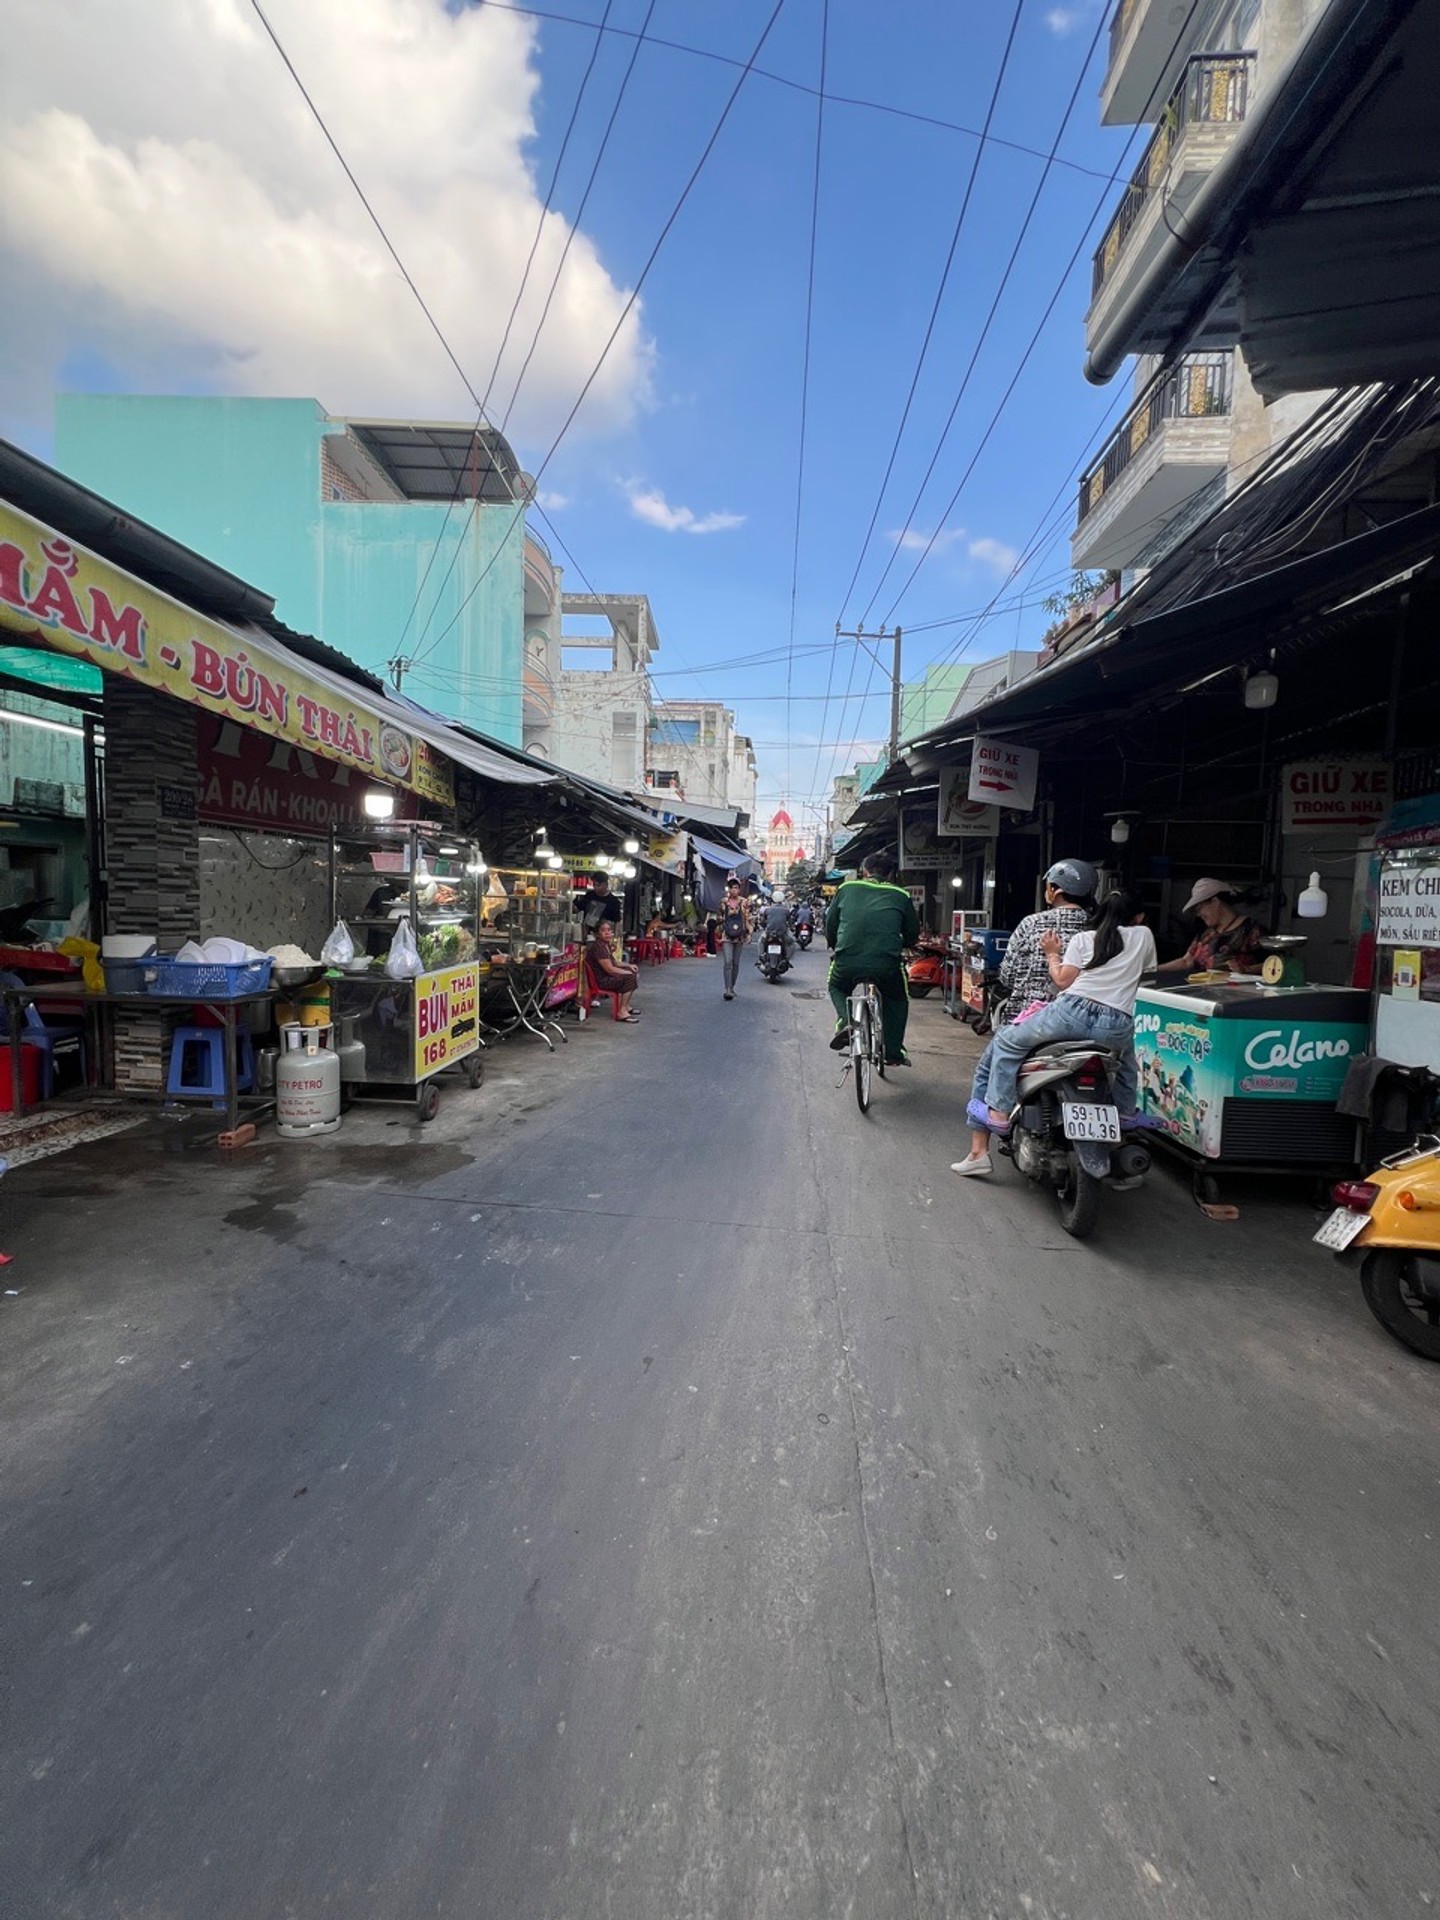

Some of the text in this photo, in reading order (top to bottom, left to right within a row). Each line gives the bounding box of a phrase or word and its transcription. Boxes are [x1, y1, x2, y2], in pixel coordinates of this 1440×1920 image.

[190, 640, 287, 725] BÚN
[297, 694, 373, 761] THÁI
[1004, 751, 1021, 766] XE
[1290, 765, 1388, 794] GIỮ XE
[231, 777, 279, 816] RÁN
[288, 792, 345, 824] KHOAI
[1293, 797, 1384, 813] TRONG NHÀ
[1382, 878, 1410, 896] KEM
[1423, 926, 1440, 941] RIÊ
[451, 970, 476, 994] THÁI
[418, 981, 448, 1038] BÚN
[423, 1038, 447, 1066] 168
[1244, 1029, 1350, 1071] Celano
[292, 1079, 323, 1090] PETRO
